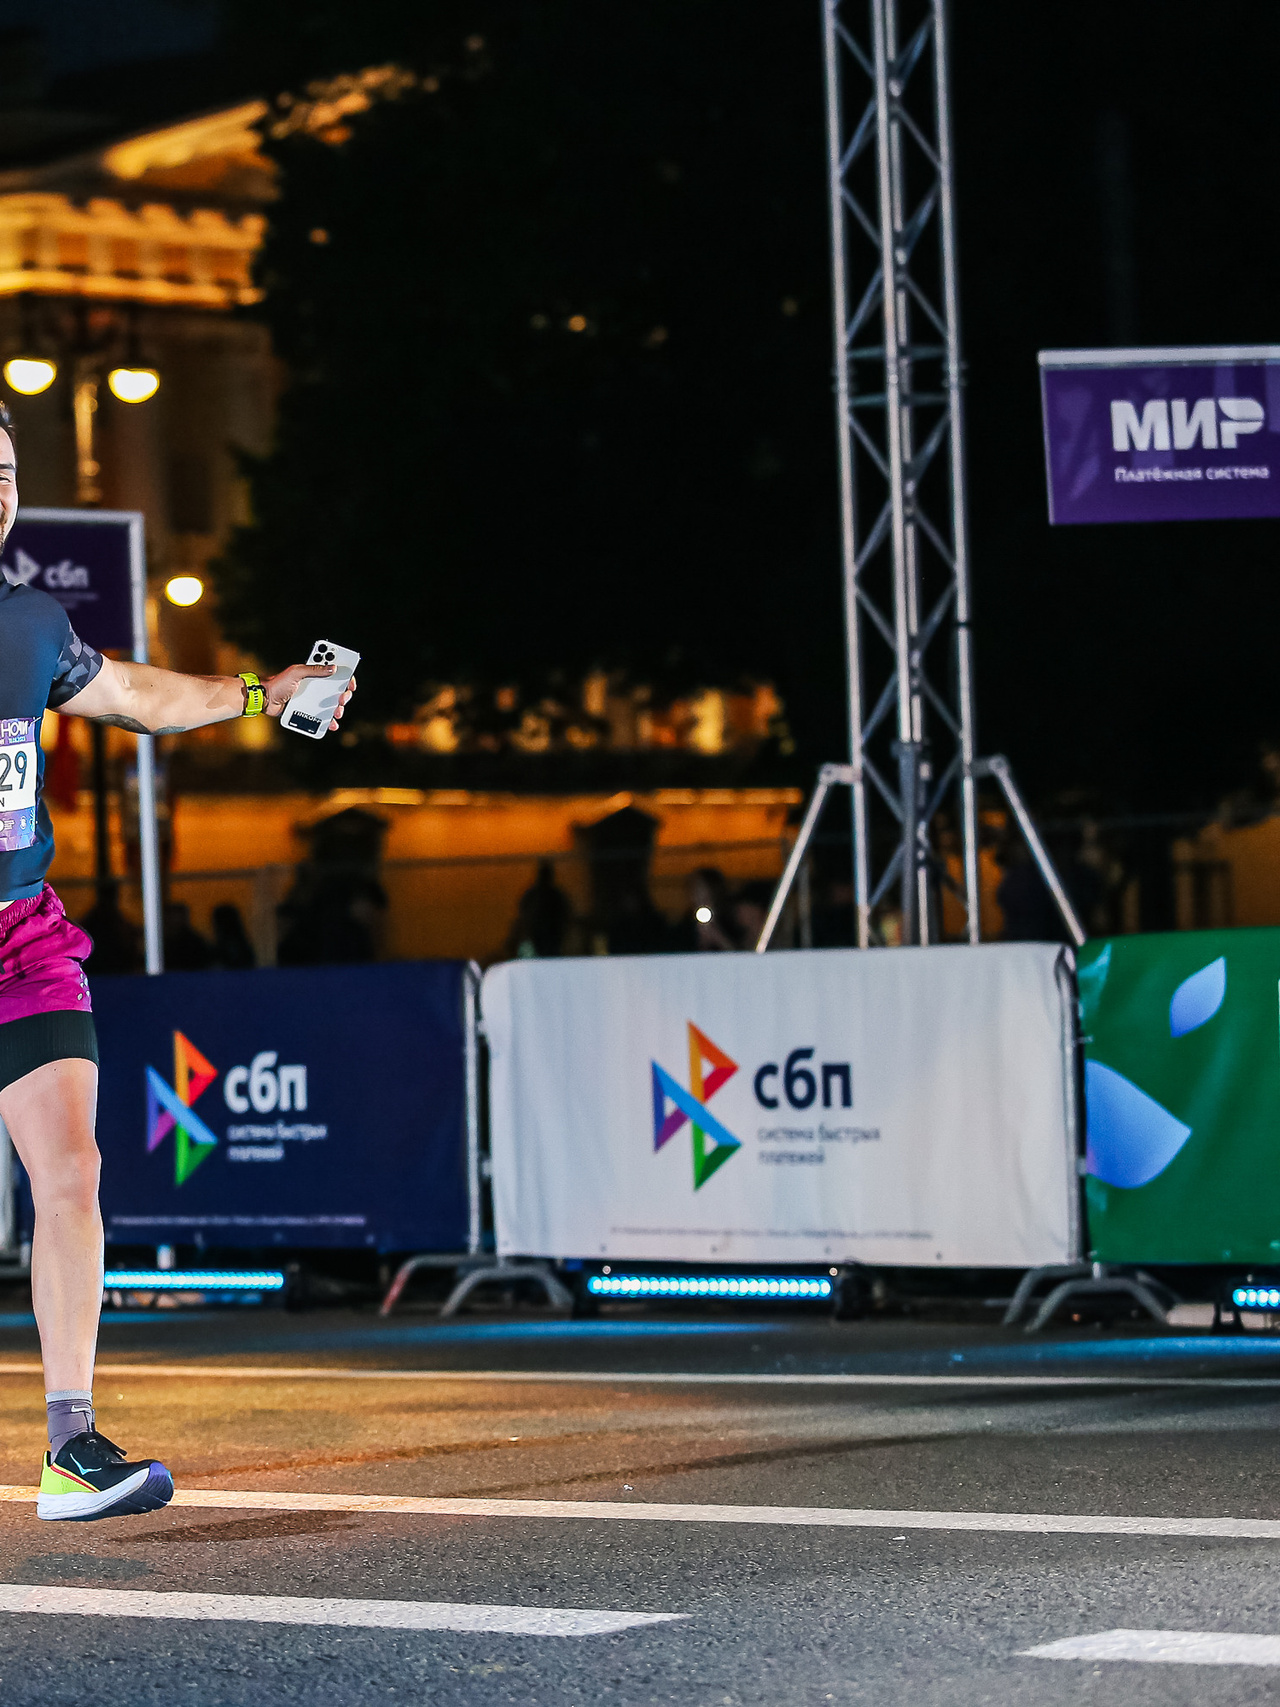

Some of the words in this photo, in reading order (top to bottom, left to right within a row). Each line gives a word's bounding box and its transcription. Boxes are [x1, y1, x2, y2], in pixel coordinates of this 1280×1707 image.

[1111, 397, 1265, 451] МИР
[1114, 466, 1203, 482] Платёжная
[1206, 465, 1270, 480] система
